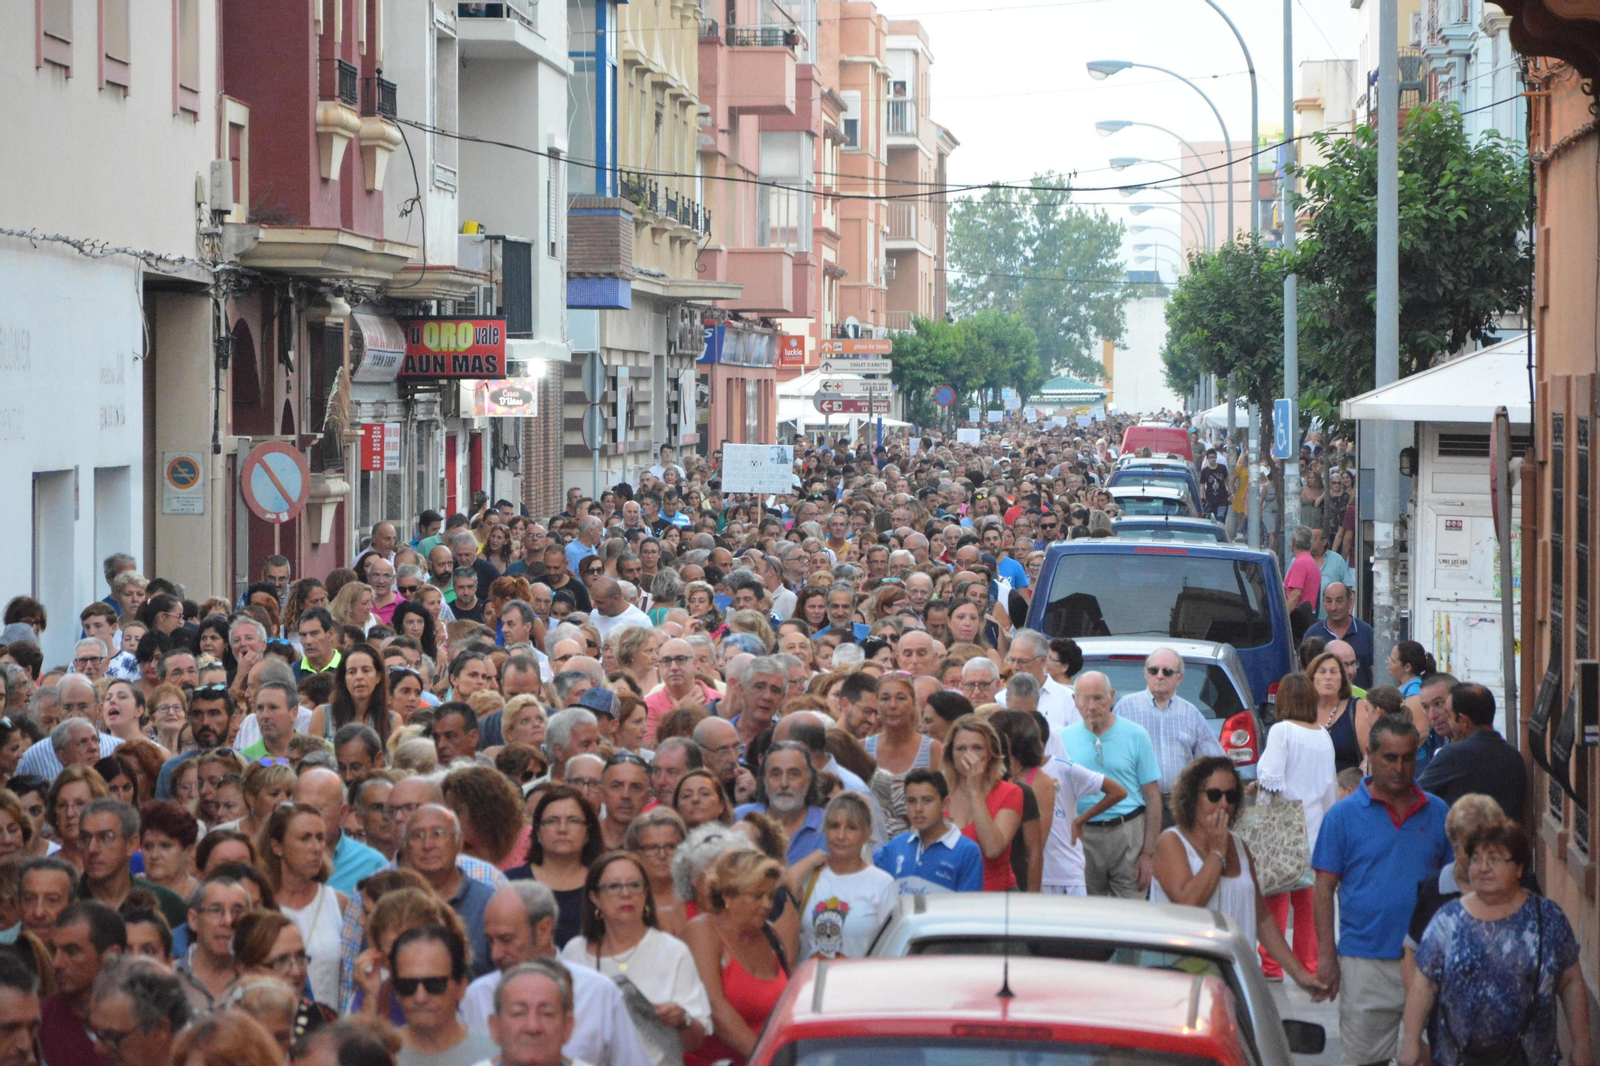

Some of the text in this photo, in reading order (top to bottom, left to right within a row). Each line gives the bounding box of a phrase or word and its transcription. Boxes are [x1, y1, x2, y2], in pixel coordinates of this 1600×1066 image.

[423, 321, 474, 352] ORO
[475, 323, 500, 346] vale
[403, 354, 446, 374] AUN
[452, 354, 498, 374] MAS
[372, 426, 382, 452] COMPRO
[372, 455, 380, 468] ORO
